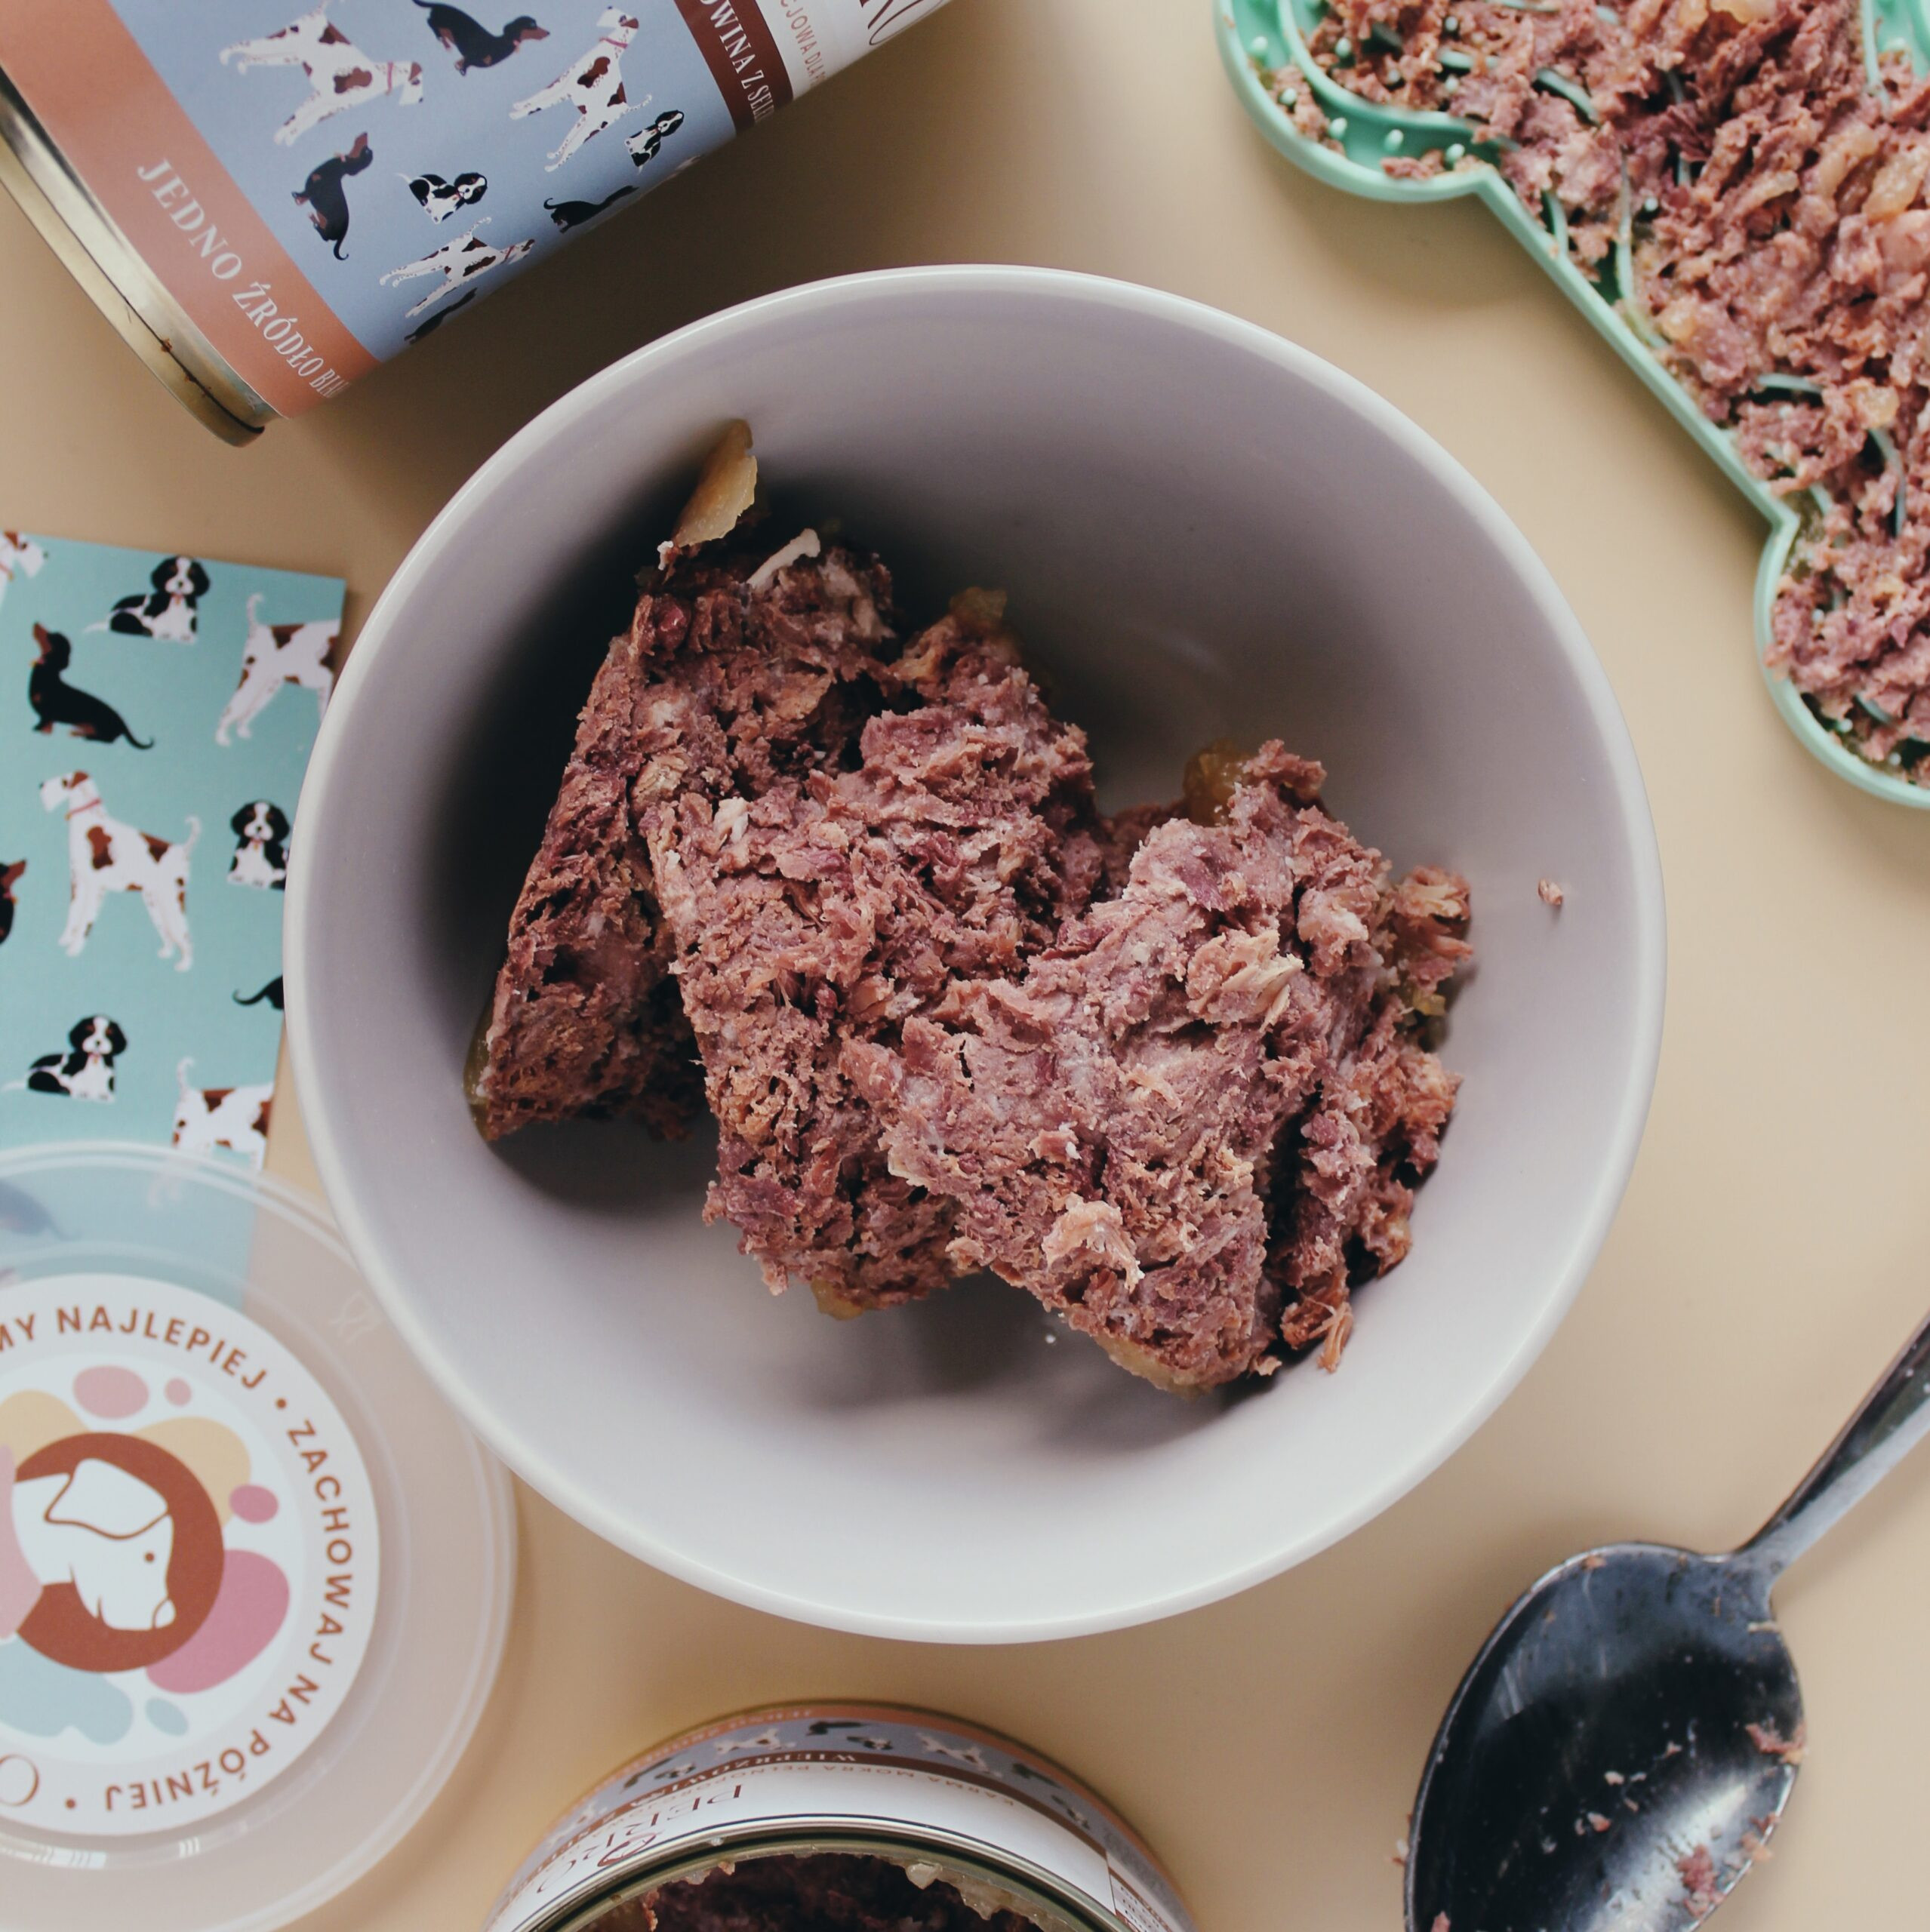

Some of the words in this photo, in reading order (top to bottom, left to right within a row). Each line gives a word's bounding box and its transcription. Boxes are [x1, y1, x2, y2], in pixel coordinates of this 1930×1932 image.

[741, 69, 765, 89] Z
[136, 157, 242, 280] JEDNO
[232, 281, 324, 377] ŹRÓDŁO
[56, 1305, 267, 1389] NAJLEPIEJ
[287, 1419, 353, 1666] ZACHOWAJ
[269, 1673, 321, 1726] NA
[104, 1727, 270, 1811] PÓŹNIEJ
[537, 1784, 742, 1894] PERRO
